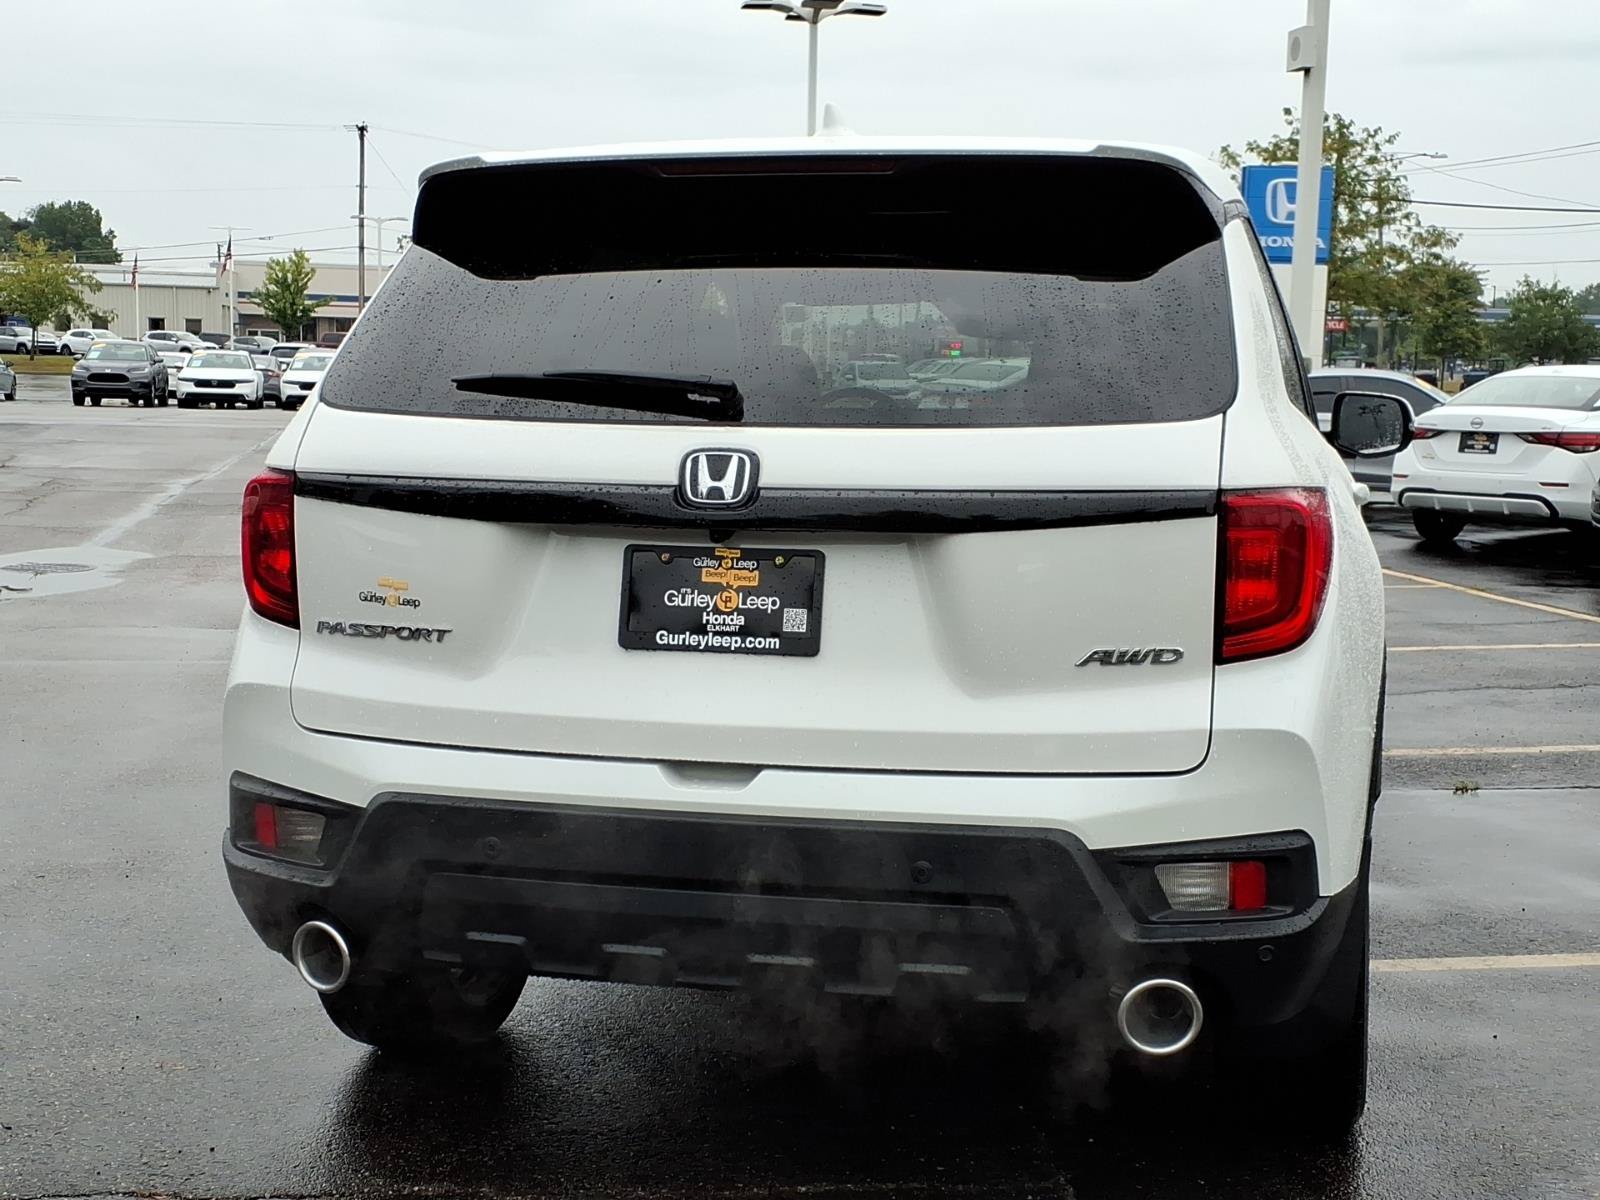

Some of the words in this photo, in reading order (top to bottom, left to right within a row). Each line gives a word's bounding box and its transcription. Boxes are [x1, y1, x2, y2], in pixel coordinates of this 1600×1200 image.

[693, 557, 720, 569] Gurley
[733, 558, 757, 570] Leep
[733, 573, 757, 583] Beep!
[397, 595, 421, 609] Leep
[664, 589, 718, 611] Gurley
[738, 592, 780, 614] Leep
[702, 611, 745, 626] Honda
[316, 620, 454, 643] PASSPORT
[706, 624, 740, 633] ELKHART
[655, 630, 780, 650] Gurleyleep.com
[1073, 646, 1186, 667] AWD
